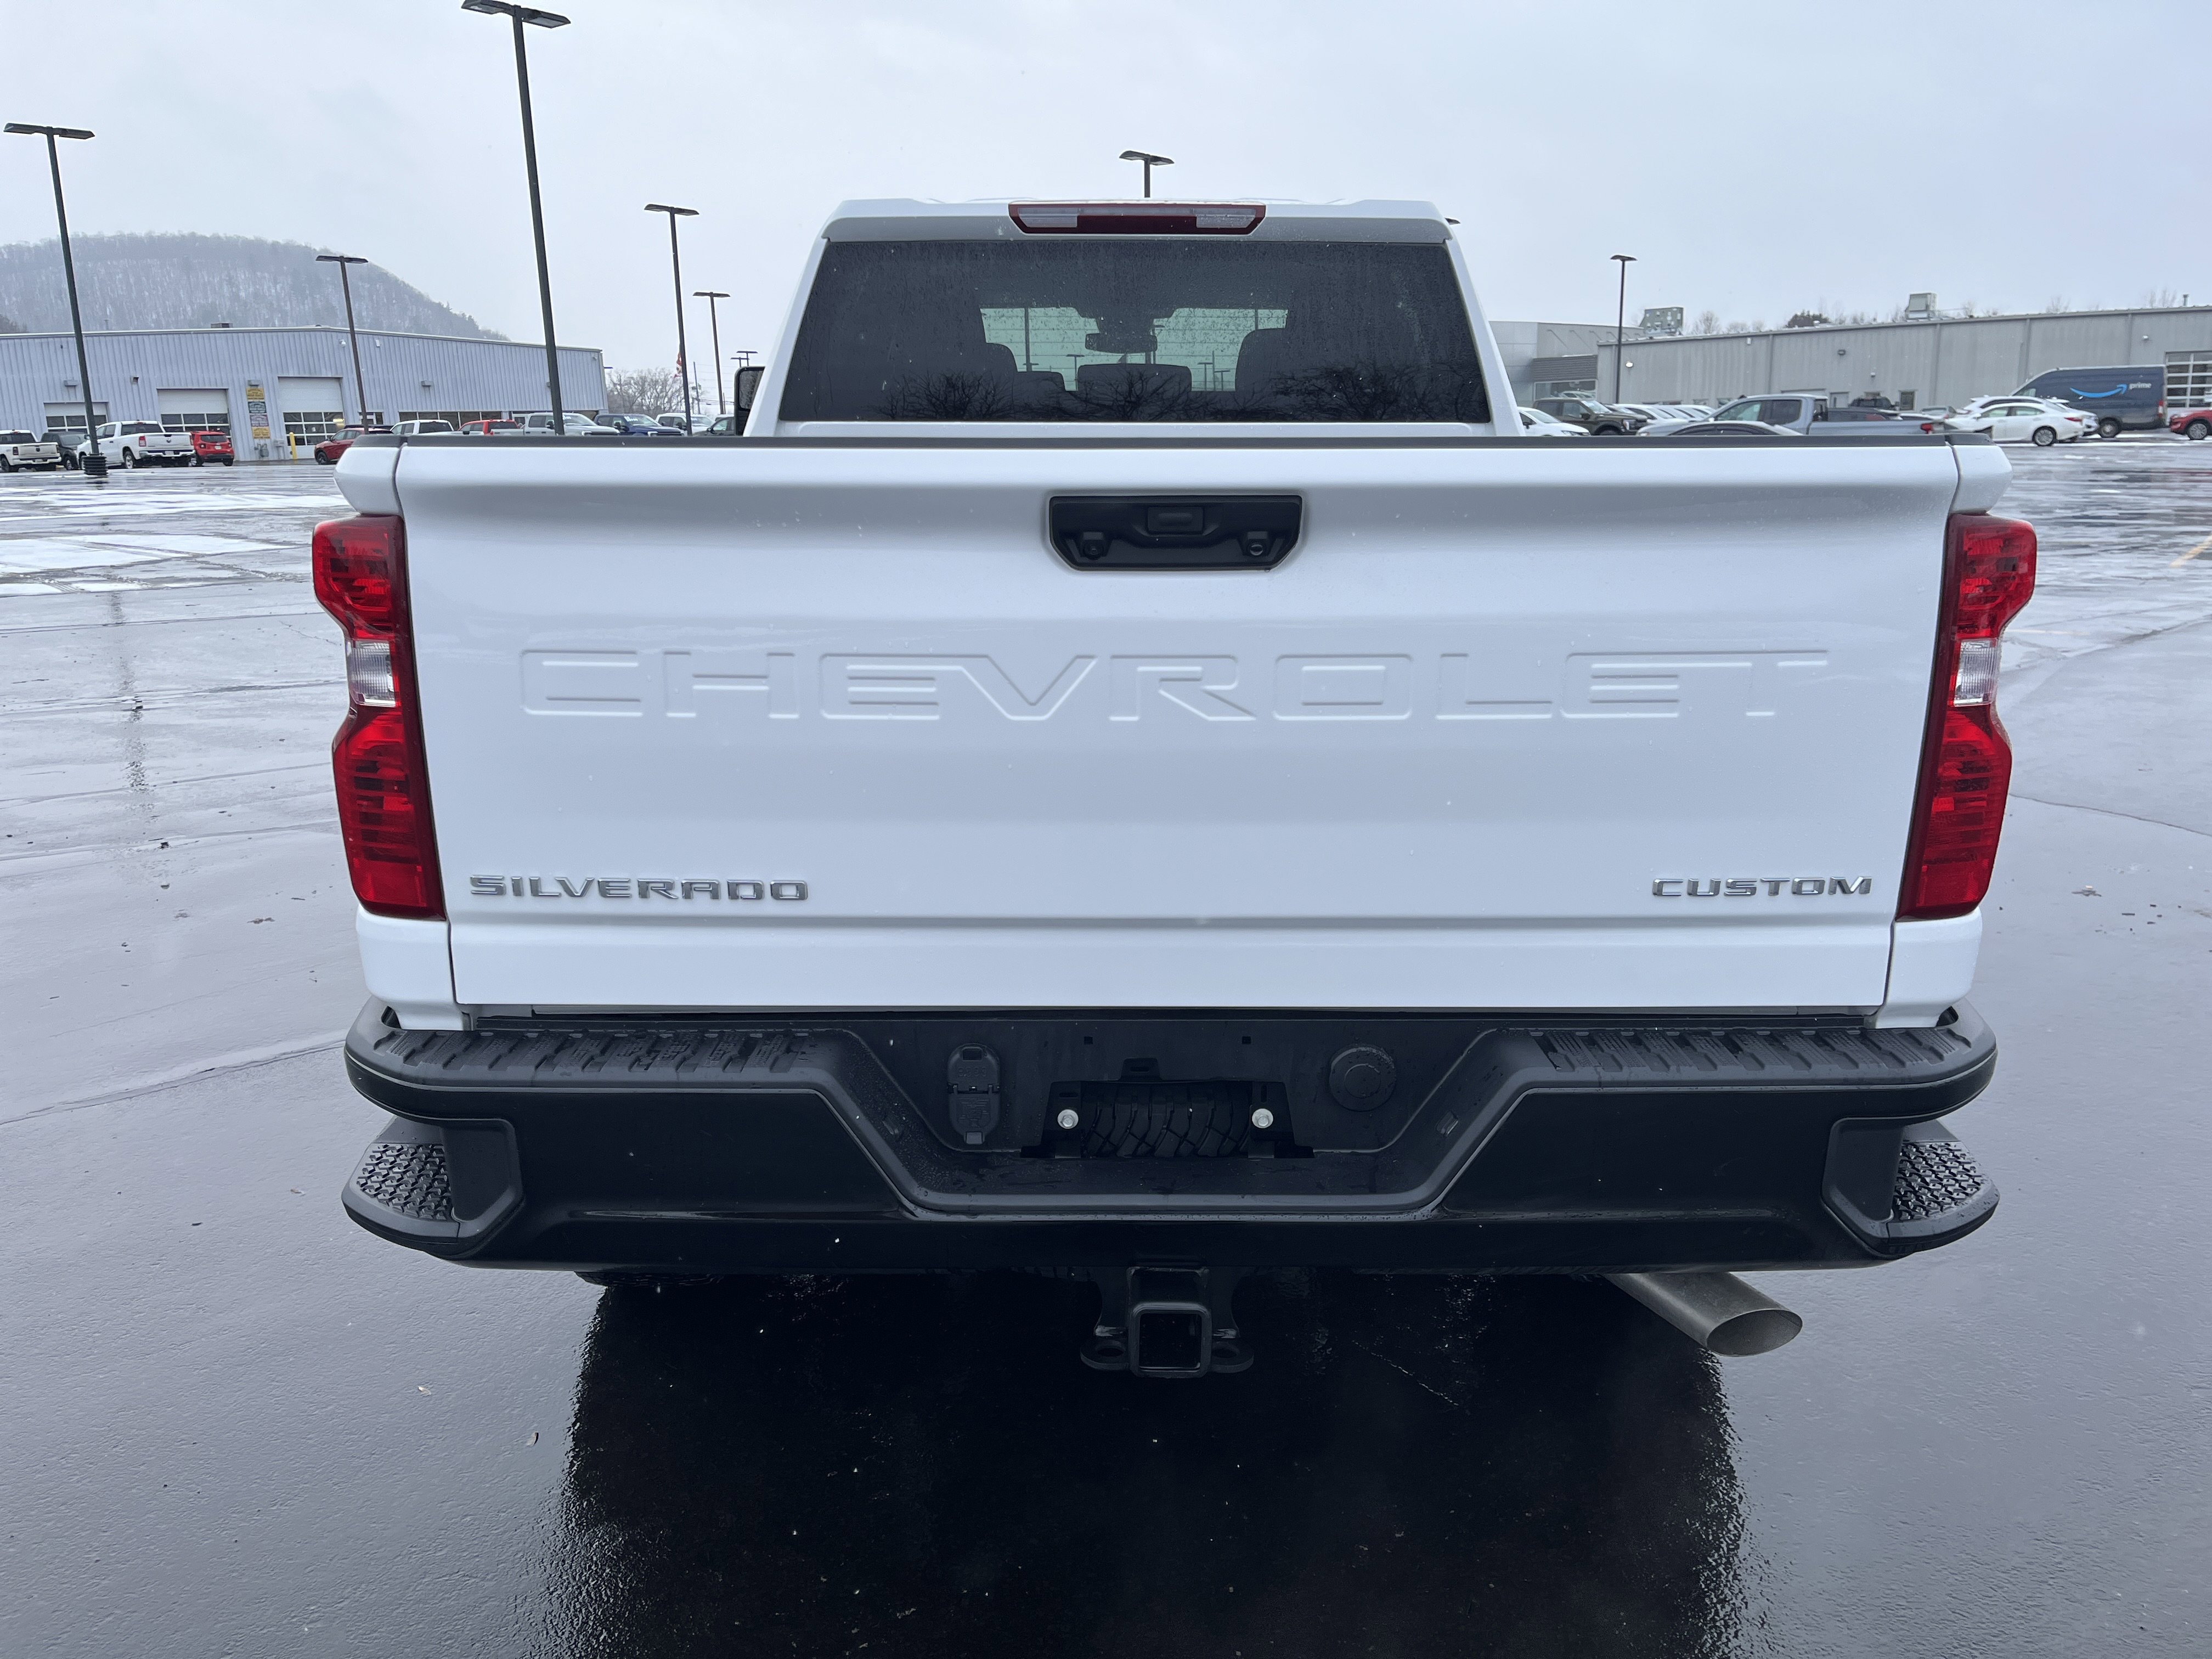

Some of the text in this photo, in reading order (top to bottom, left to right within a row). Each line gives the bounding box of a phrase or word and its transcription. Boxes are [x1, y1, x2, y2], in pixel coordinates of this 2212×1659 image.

[520, 648, 1829, 723] CHEVROLET
[470, 874, 809, 900] SILVERADO
[1652, 876, 1872, 897] CUSTOM
